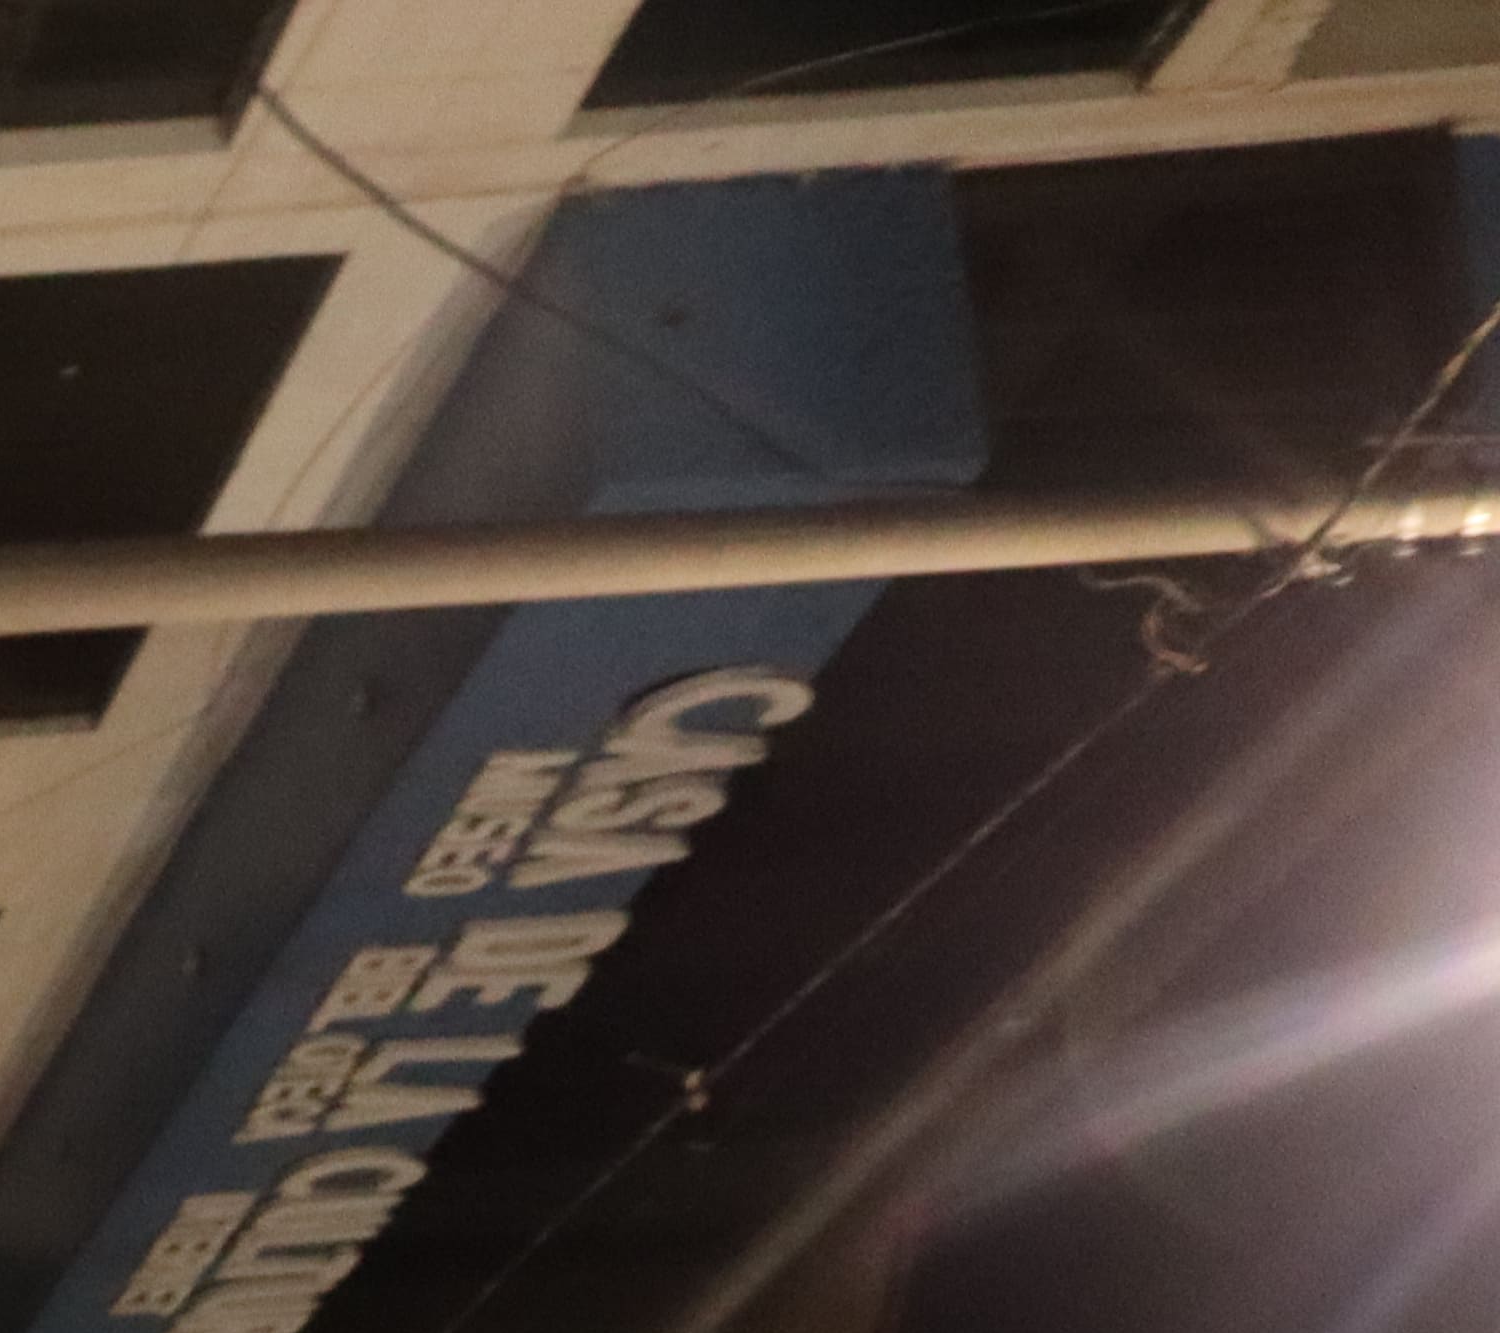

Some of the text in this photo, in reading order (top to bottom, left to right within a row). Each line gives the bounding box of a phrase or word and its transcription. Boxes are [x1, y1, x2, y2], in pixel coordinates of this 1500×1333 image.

[401, 750, 580, 897] MUSEO
[504, 666, 814, 889] CASA
[408, 911, 630, 1012] DE
[231, 945, 437, 1145] BIBLOTECA
[321, 1035, 523, 1132] LA
